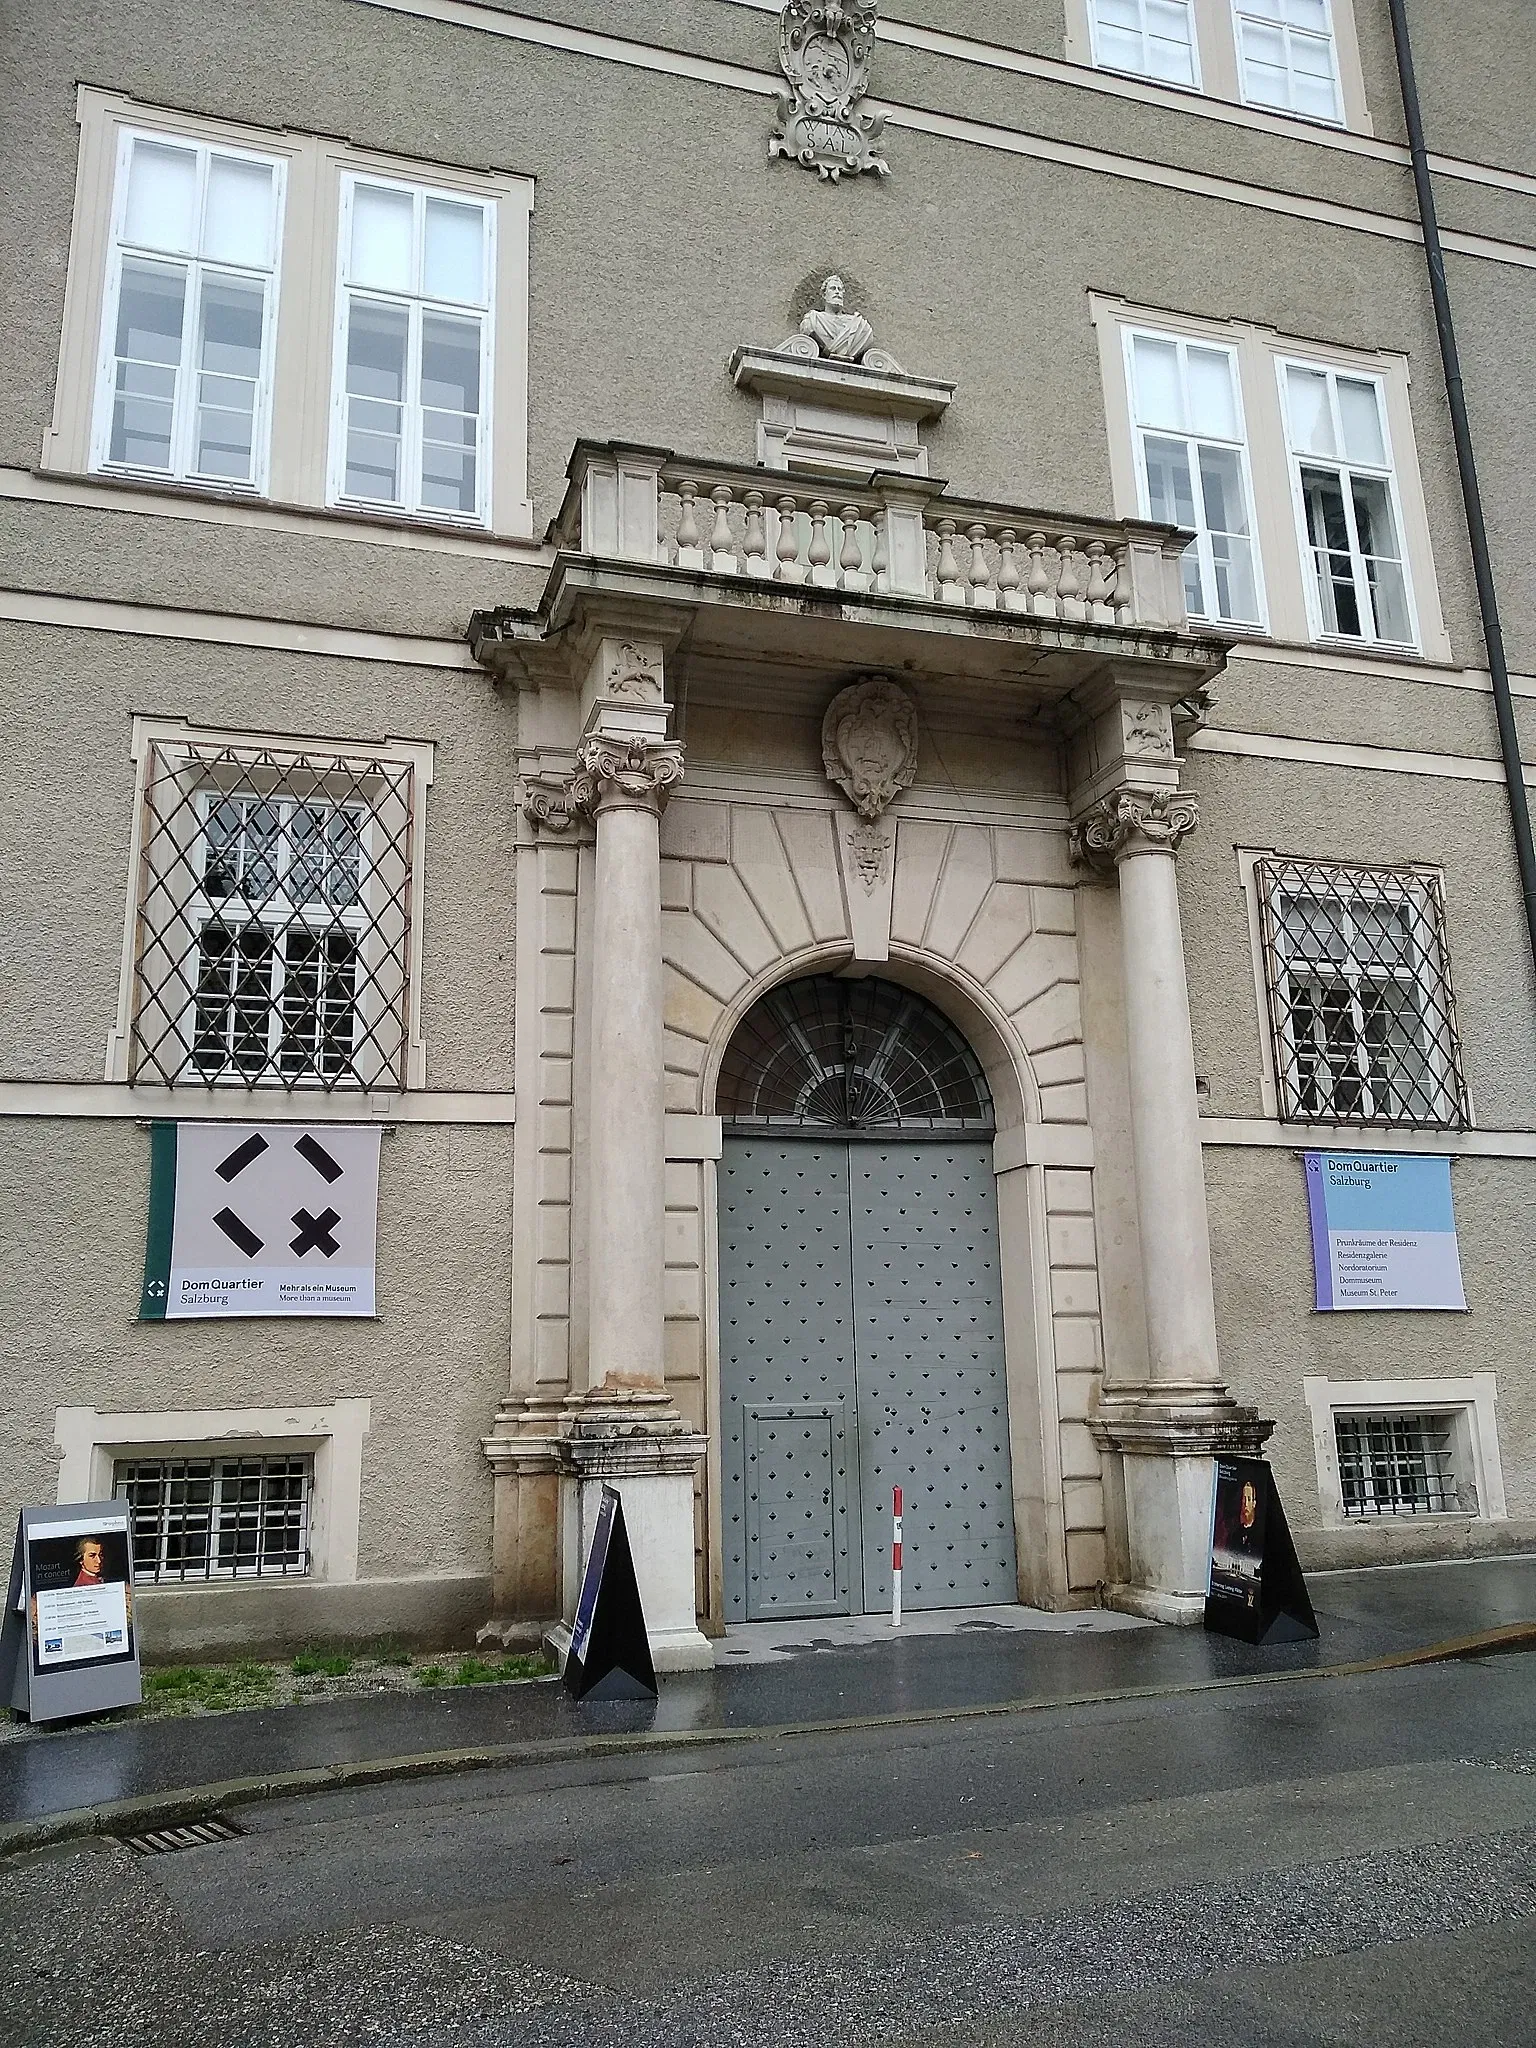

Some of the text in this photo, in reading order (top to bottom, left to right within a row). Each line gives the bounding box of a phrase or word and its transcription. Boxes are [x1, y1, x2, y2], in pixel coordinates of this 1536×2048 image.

[1330, 1175, 1371, 1189] Salzburg
[1336, 1238, 1418, 1247] Prunkräume der Residenz
[1337, 1251, 1388, 1261] Residenzgalerie
[1338, 1264, 1388, 1272] Nordoratorium
[1339, 1276, 1382, 1284] Dommuseum
[279, 1284, 357, 1292] Mehr als ein Museum
[1340, 1289, 1368, 1297] Museum
[1380, 1289, 1398, 1297] Peter
[180, 1294, 229, 1306] Salzburg
[279, 1294, 298, 1302] More
[299, 1294, 315, 1302] than
[35, 1562, 61, 1572] Mozart
[44, 1569, 71, 1579] concert
